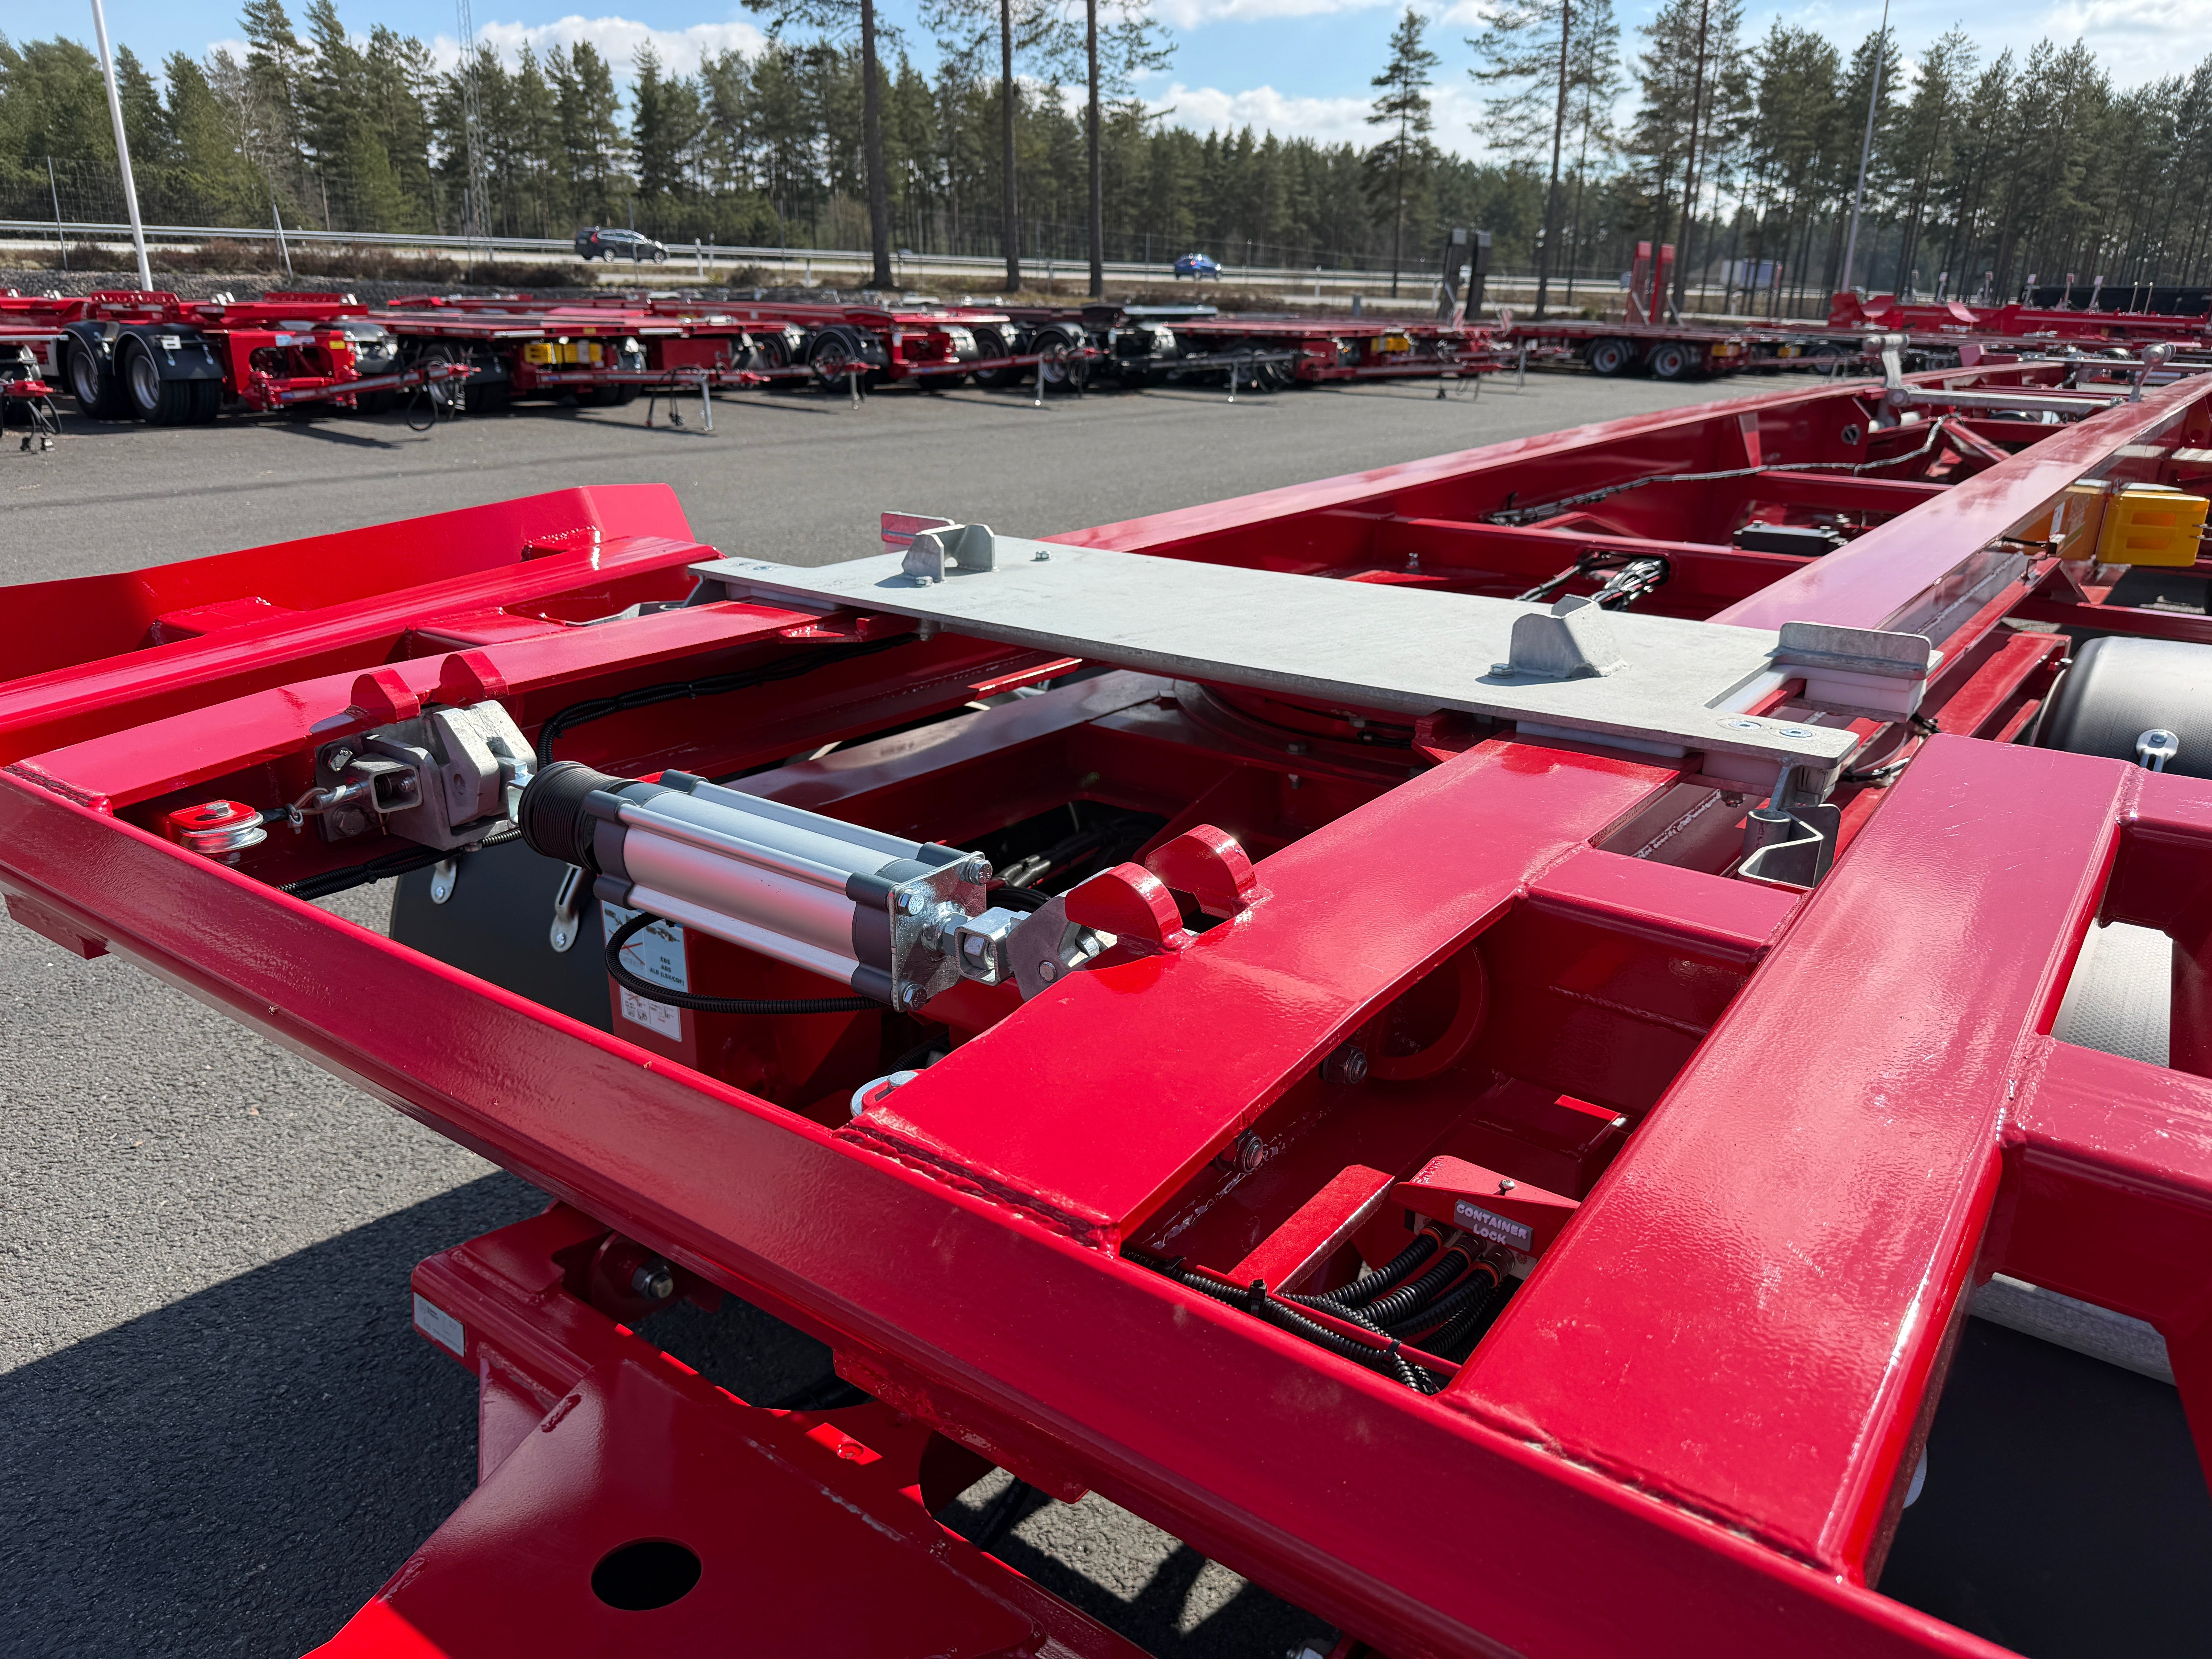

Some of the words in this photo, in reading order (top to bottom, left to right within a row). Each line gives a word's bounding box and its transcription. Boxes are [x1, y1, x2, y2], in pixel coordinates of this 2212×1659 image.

[660, 956, 671, 965] EBS
[650, 967, 659, 975] ALB
[661, 964, 672, 973] ABS
[1456, 1204, 1527, 1240] CONTAINER
[1473, 1224, 1506, 1245] LOCK
